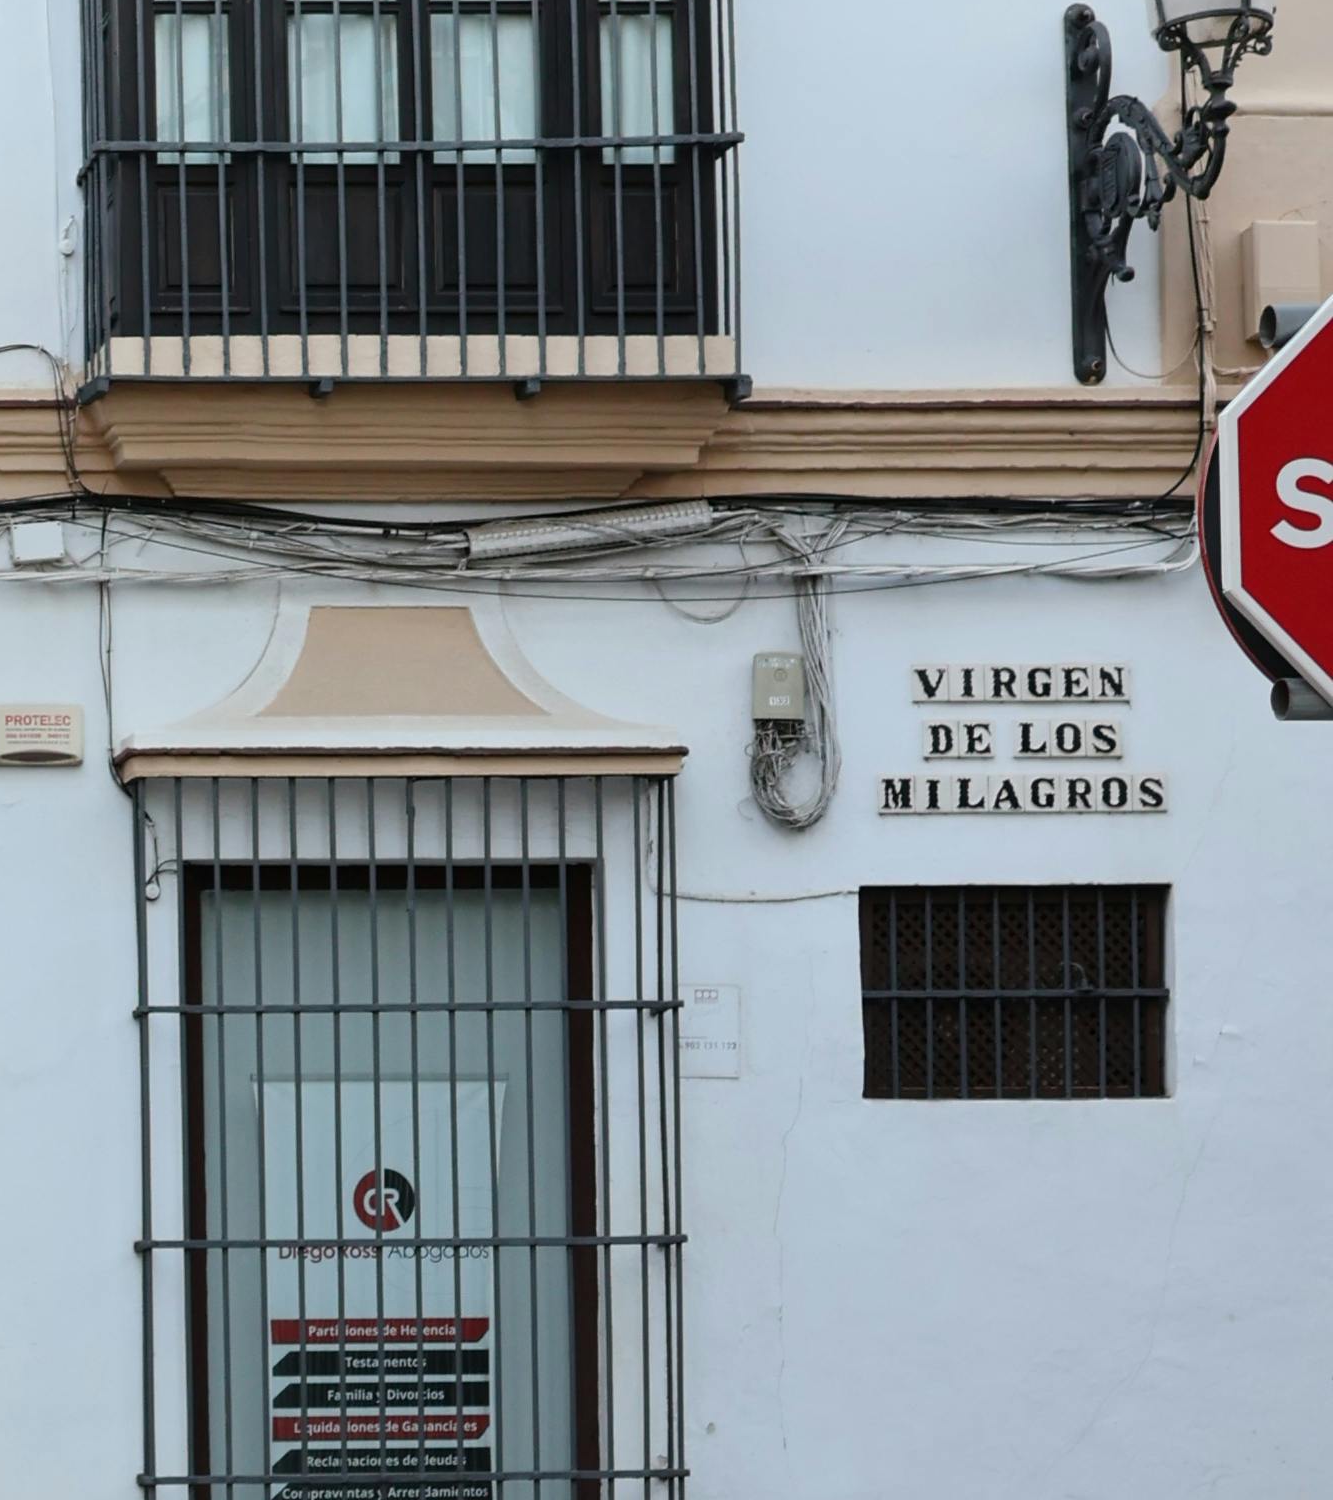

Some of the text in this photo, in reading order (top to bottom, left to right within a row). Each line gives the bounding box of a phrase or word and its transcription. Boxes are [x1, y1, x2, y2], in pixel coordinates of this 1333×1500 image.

[913, 667, 1124, 698] VIRGEN
[5, 715, 71, 726] PROTELEC
[928, 722, 1117, 754] DE LOS
[881, 777, 1164, 809] MILAGROS
[308, 1324, 456, 1336] Partiiones de Heencia
[294, 1421, 380, 1435] Lquidaiones
[402, 1421, 477, 1432] Gaanciaes
[403, 1456, 418, 1467] de
